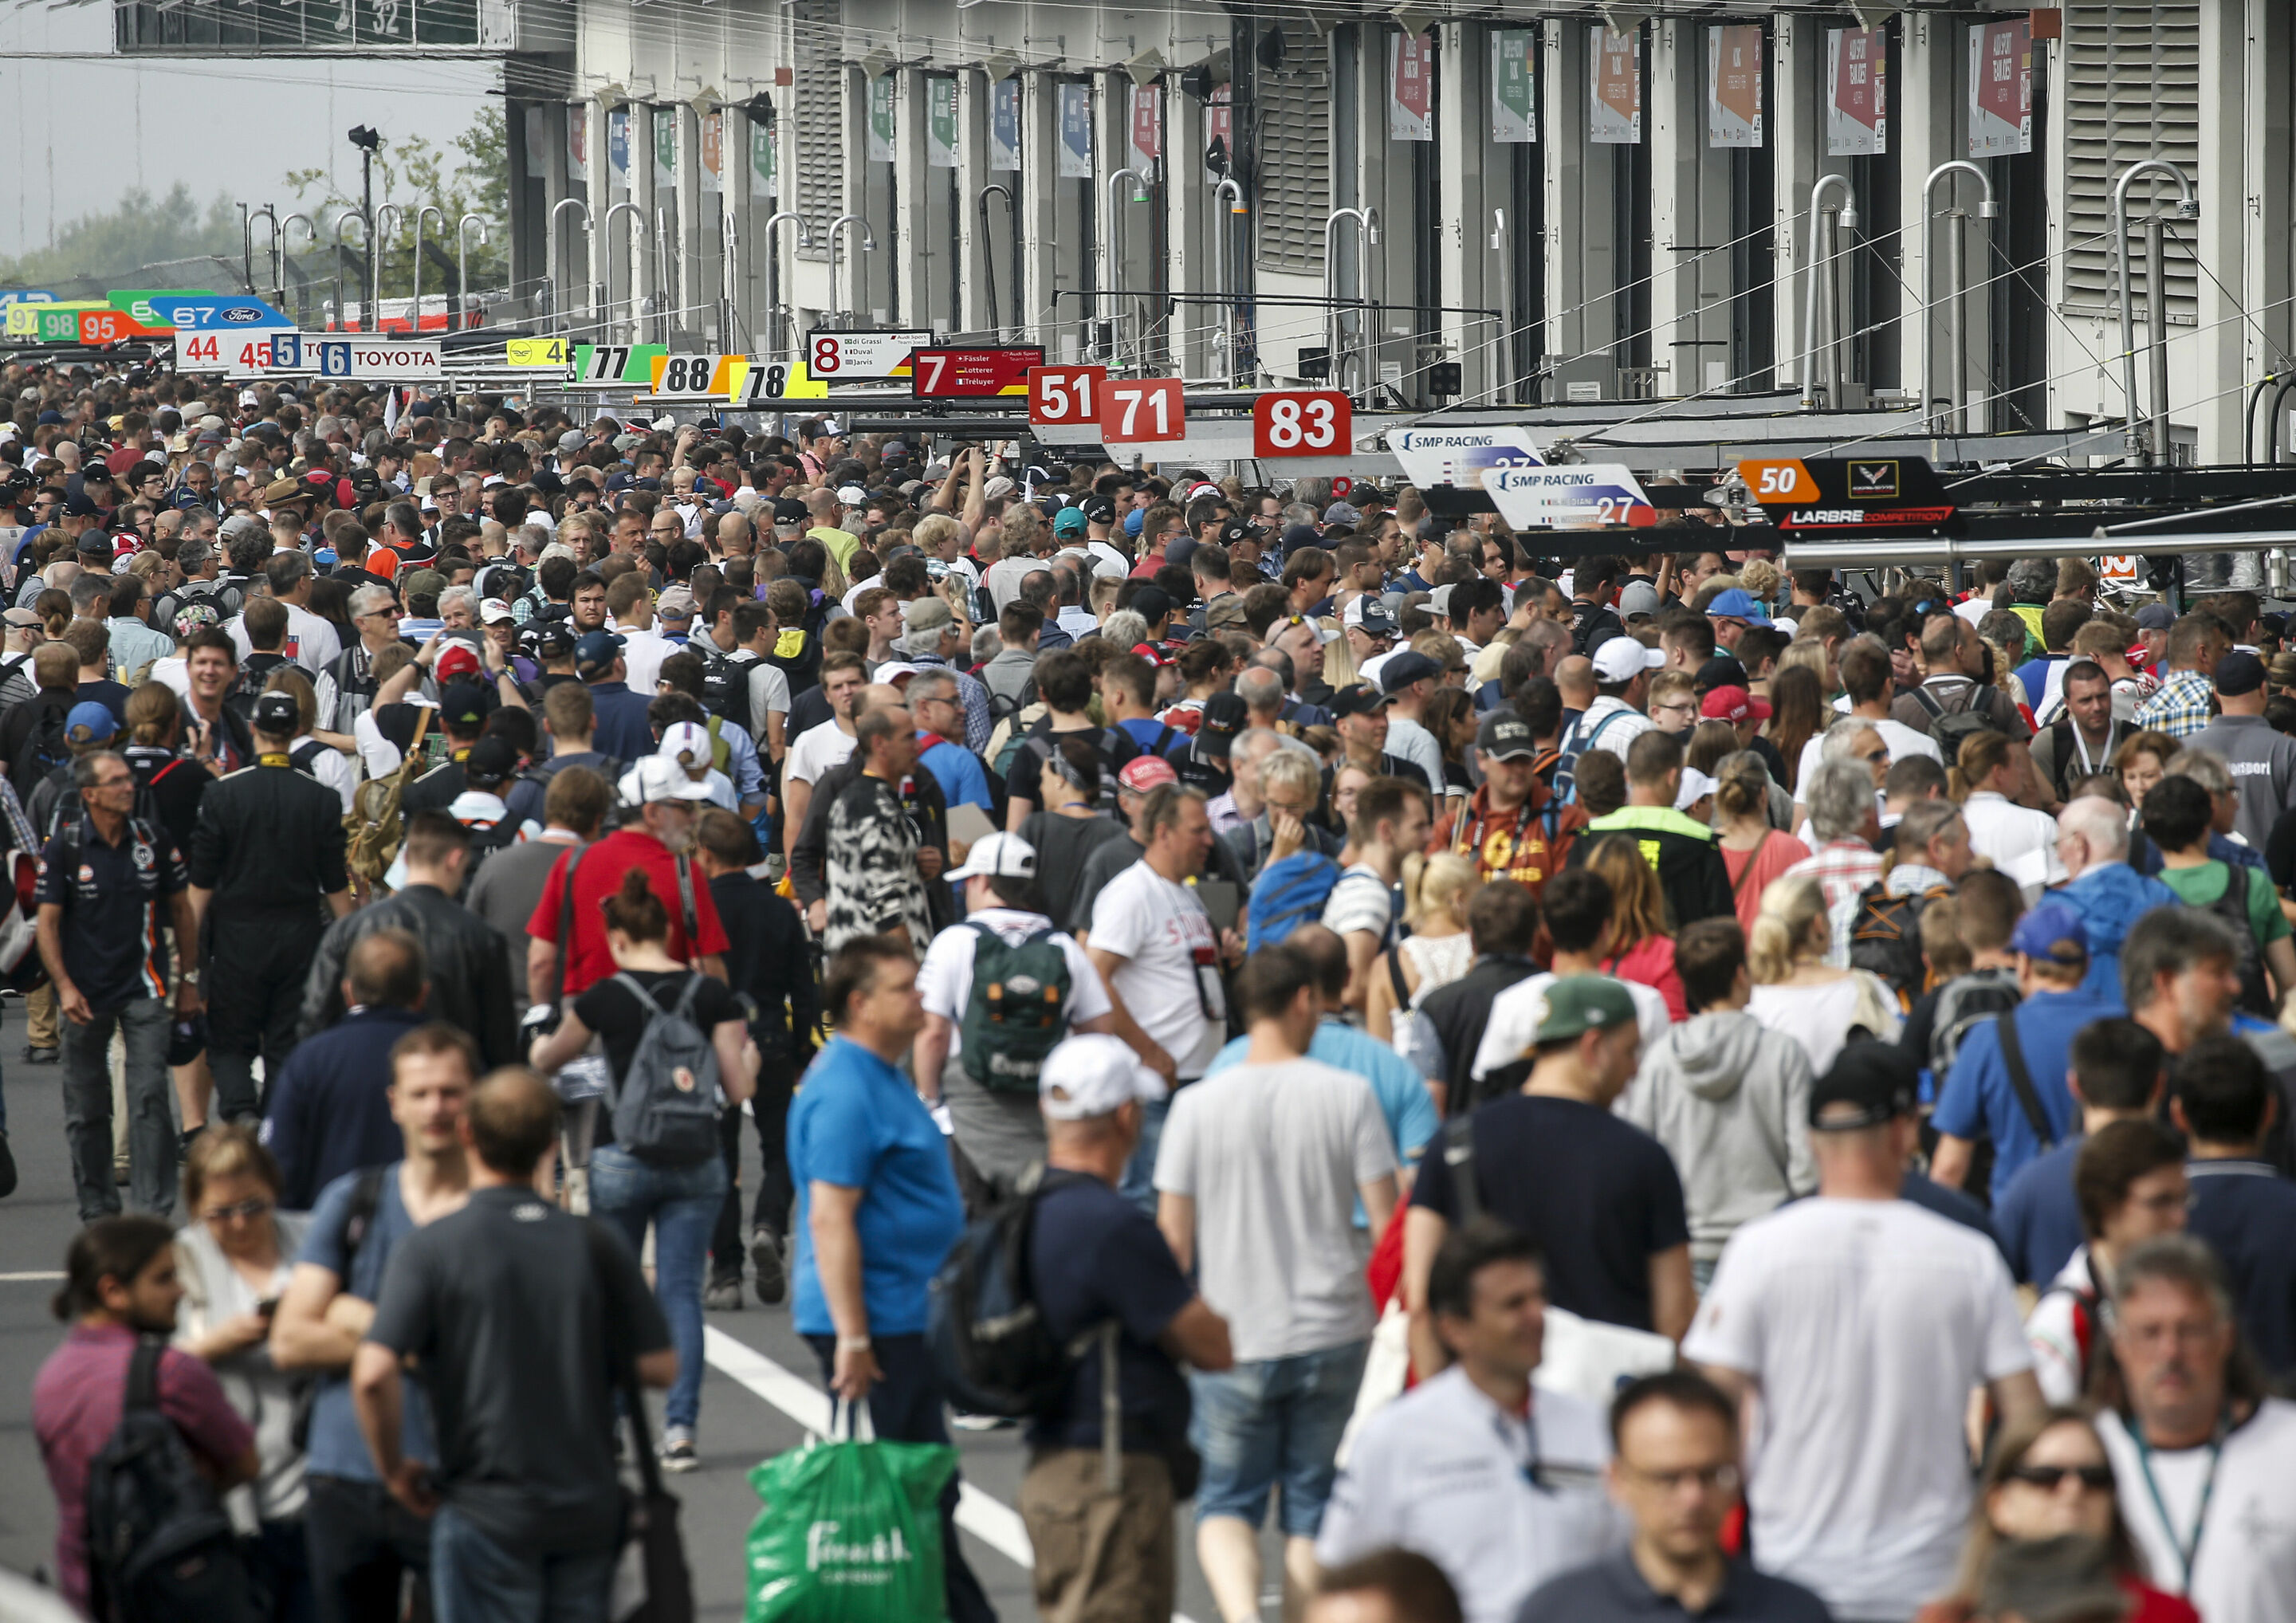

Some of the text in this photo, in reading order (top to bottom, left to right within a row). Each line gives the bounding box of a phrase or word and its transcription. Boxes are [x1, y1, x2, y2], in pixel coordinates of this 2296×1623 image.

[12, 309, 38, 329] 97
[45, 314, 75, 336] 98
[85, 316, 115, 340] 95
[173, 307, 255, 324] 67 Ford
[187, 336, 219, 361] 44
[239, 343, 272, 368] 45
[277, 336, 294, 366] 5
[327, 345, 345, 375] 6
[355, 352, 436, 366] TOYOTA
[546, 341, 563, 363] 4
[815, 338, 840, 372] 8
[596, 348, 628, 379] 77
[667, 359, 710, 391] 88
[919, 356, 946, 393] 7
[749, 365, 785, 399] 78
[965, 378, 995, 387] Tréluyer
[1040, 373, 1092, 419] 51
[1114, 389, 1169, 436] 71
[1269, 399, 1336, 448] 83
[1415, 435, 1493, 448] SMP RACING
[1512, 474, 1594, 488] SMP RACING
[1759, 467, 1797, 494] 50
[1597, 497, 1635, 524] 27
[1791, 509, 1864, 524] LARBRE
